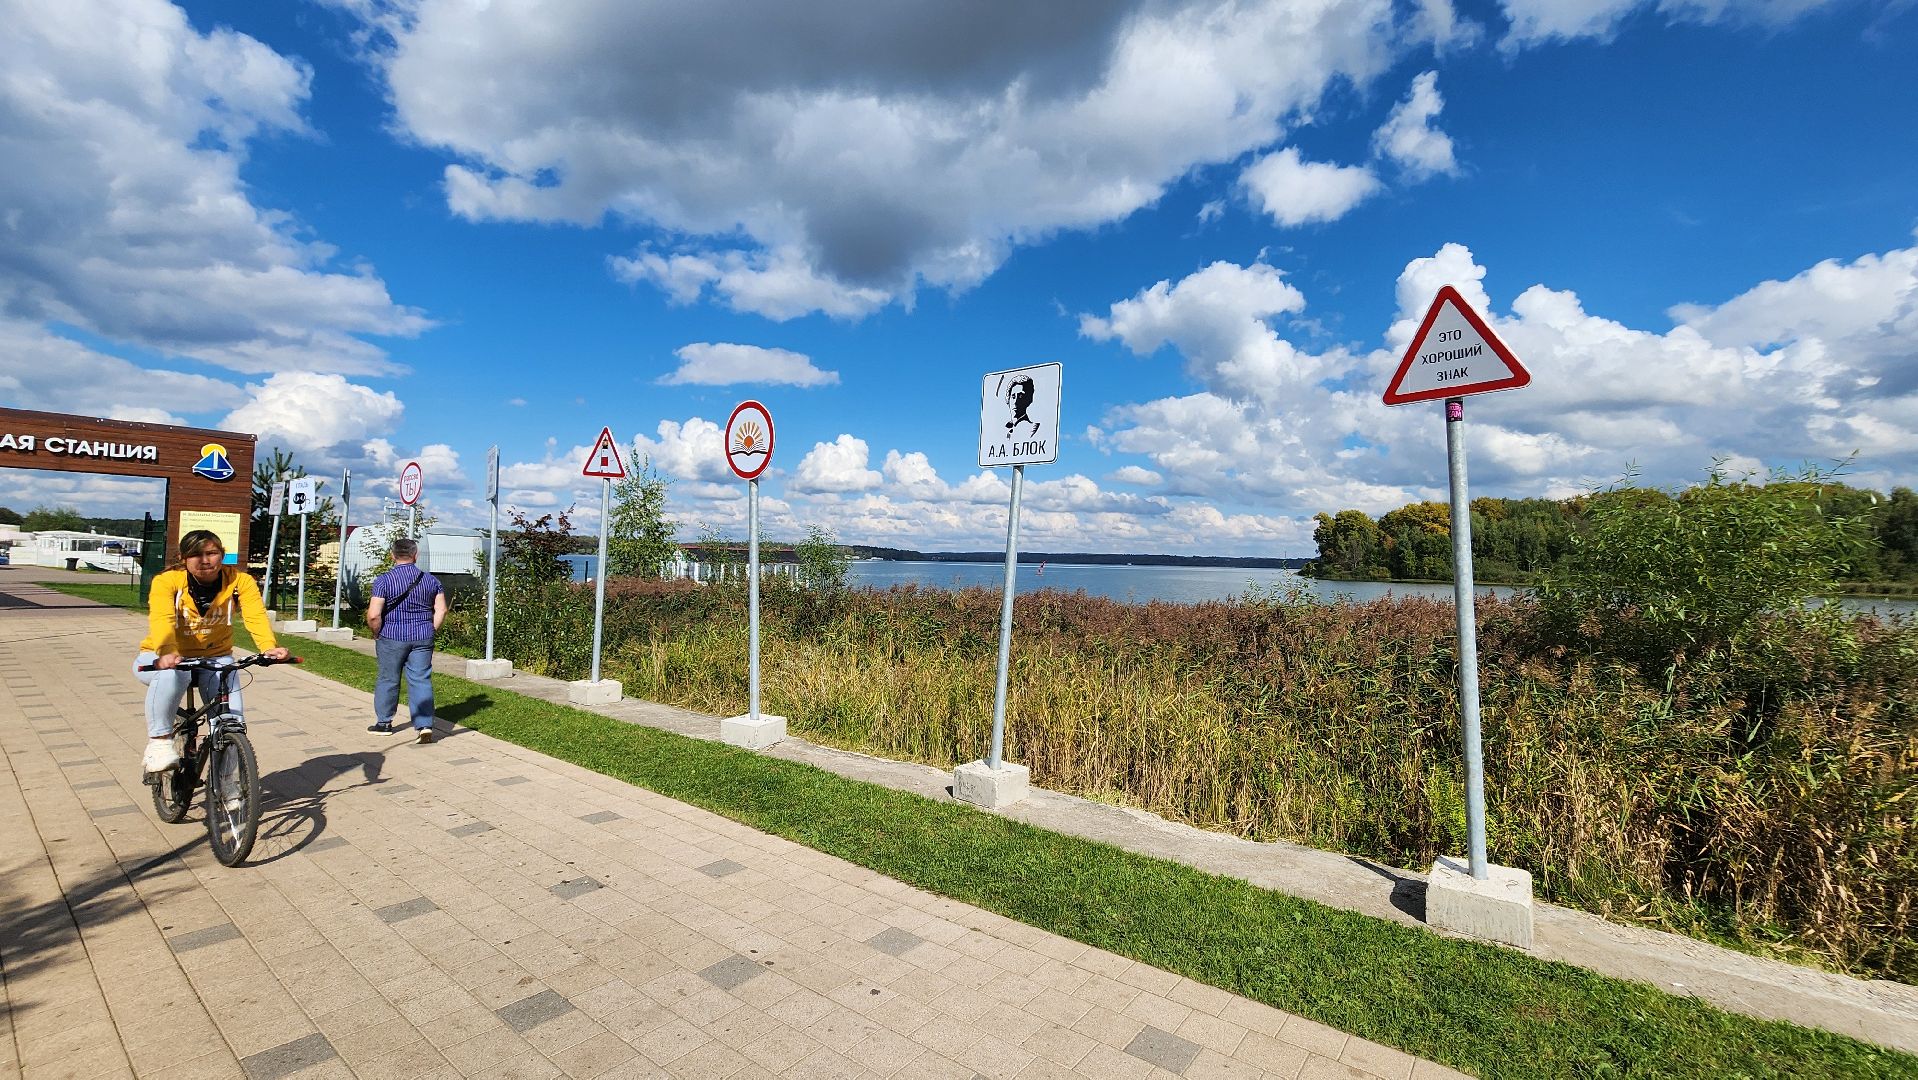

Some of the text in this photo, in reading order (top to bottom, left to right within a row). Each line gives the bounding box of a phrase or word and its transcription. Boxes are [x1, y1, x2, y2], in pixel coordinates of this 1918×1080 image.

[1438, 329, 1462, 343] ЭТО
[1421, 342, 1482, 365] ХОРОШИЙ
[1436, 366, 1468, 382] ЗНАК
[0, 433, 157, 460] АЯ СТАНЦИЯ
[988, 440, 1046, 458] А.А. БЛОК
